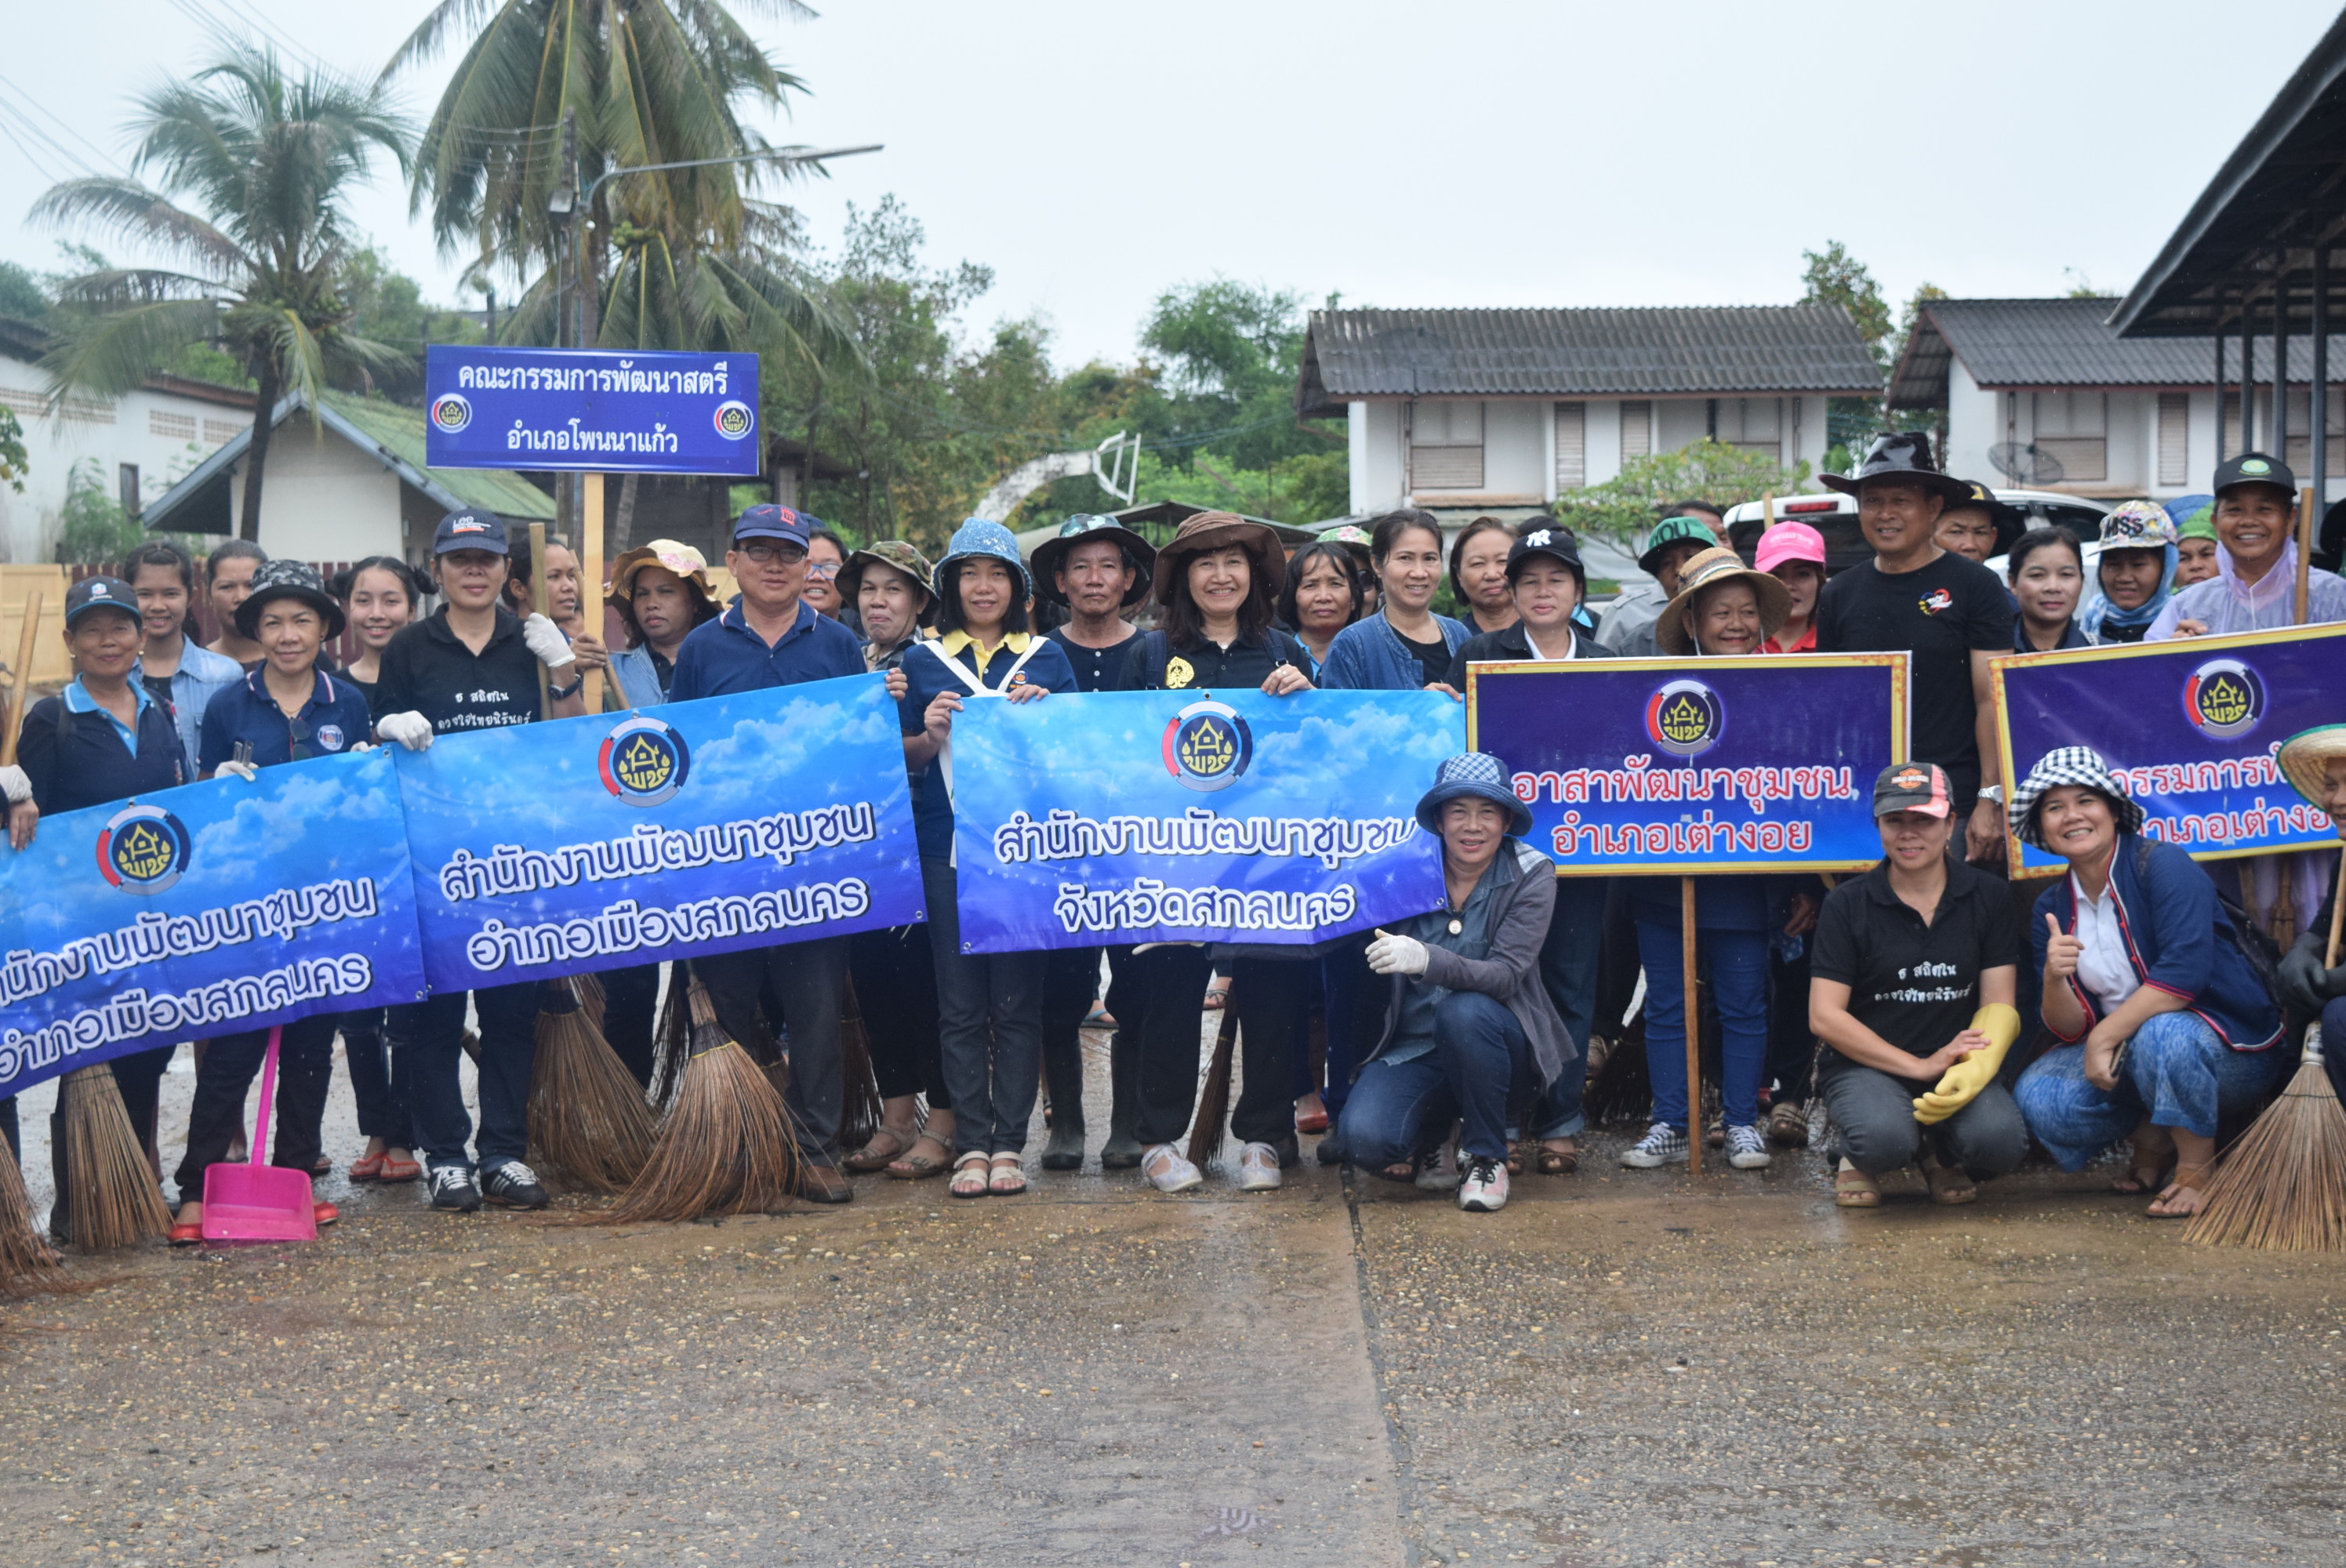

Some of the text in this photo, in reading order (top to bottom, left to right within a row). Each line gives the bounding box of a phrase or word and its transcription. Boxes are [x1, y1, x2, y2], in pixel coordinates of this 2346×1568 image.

[459, 359, 728, 395] คณะกรรมการพัฒนาสตรี
[507, 418, 678, 453] อำเภอโพนนาแก้ว
[1511, 754, 1851, 814] อาสาพัฒนาชุมชน
[440, 802, 875, 902] สำนักงานพัฒนาชุมชน
[1552, 810, 1811, 856] อำเภอเต่างอย
[467, 877, 867, 971] อำเภอเมืองสกลนคร
[1054, 877, 1356, 933] จังหวัดสกลนคร
